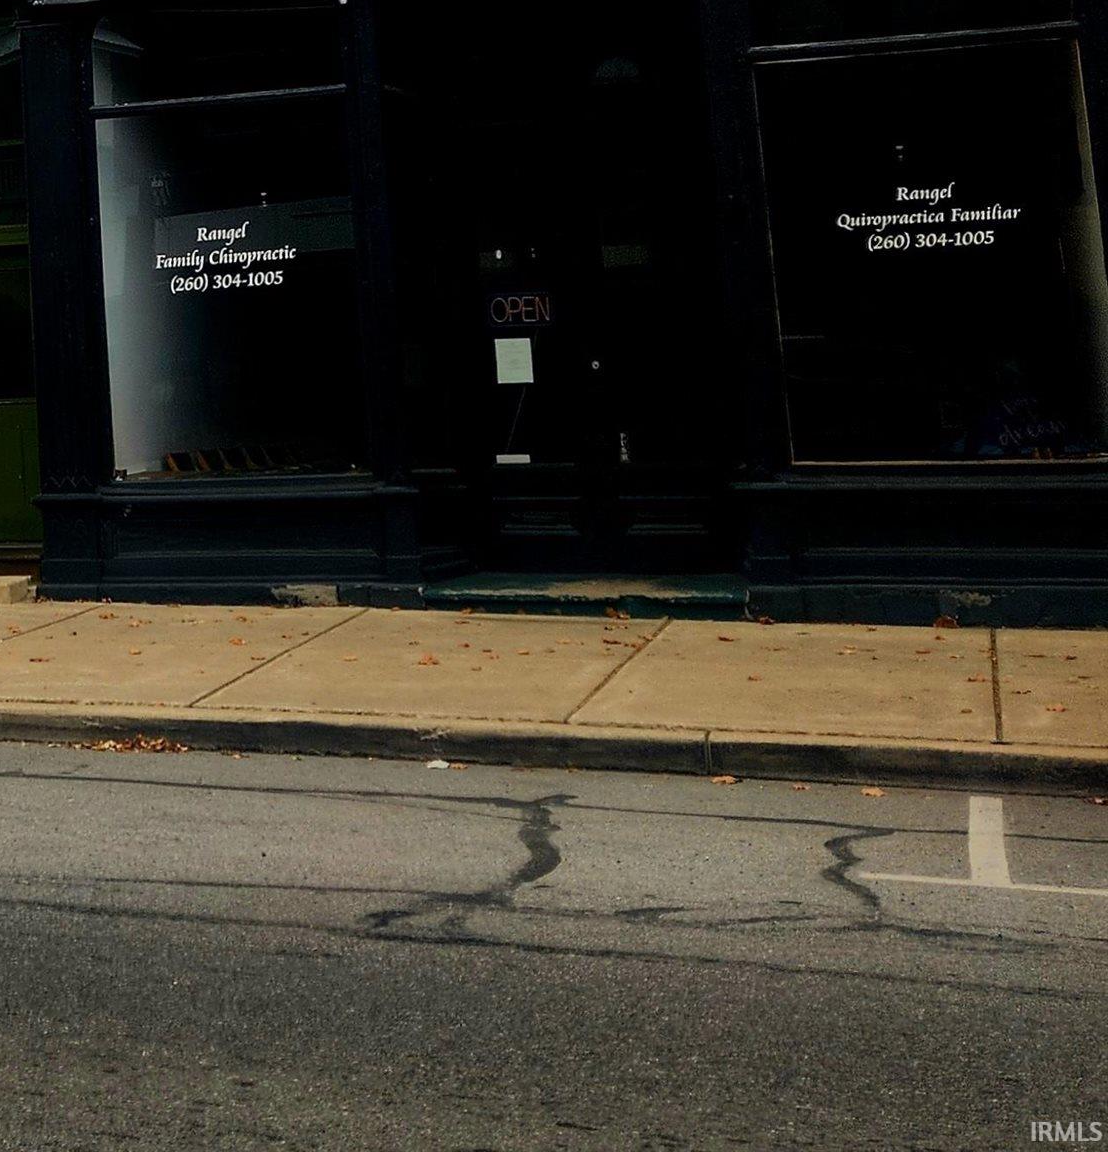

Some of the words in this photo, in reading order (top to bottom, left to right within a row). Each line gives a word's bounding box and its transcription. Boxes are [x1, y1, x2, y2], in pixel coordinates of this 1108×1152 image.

[896, 181, 955, 205] Rangel
[836, 209, 945, 232] Quiropractica
[951, 203, 1021, 222] Familiar
[196, 221, 249, 246] Rangel
[867, 231, 910, 252] (260)
[915, 230, 995, 248] 304-1005
[155, 249, 205, 272] Family
[209, 245, 297, 269] Chiropractic
[170, 273, 209, 294] (260)
[213, 270, 284, 290] 304-1005
[491, 296, 550, 322] OPEN
